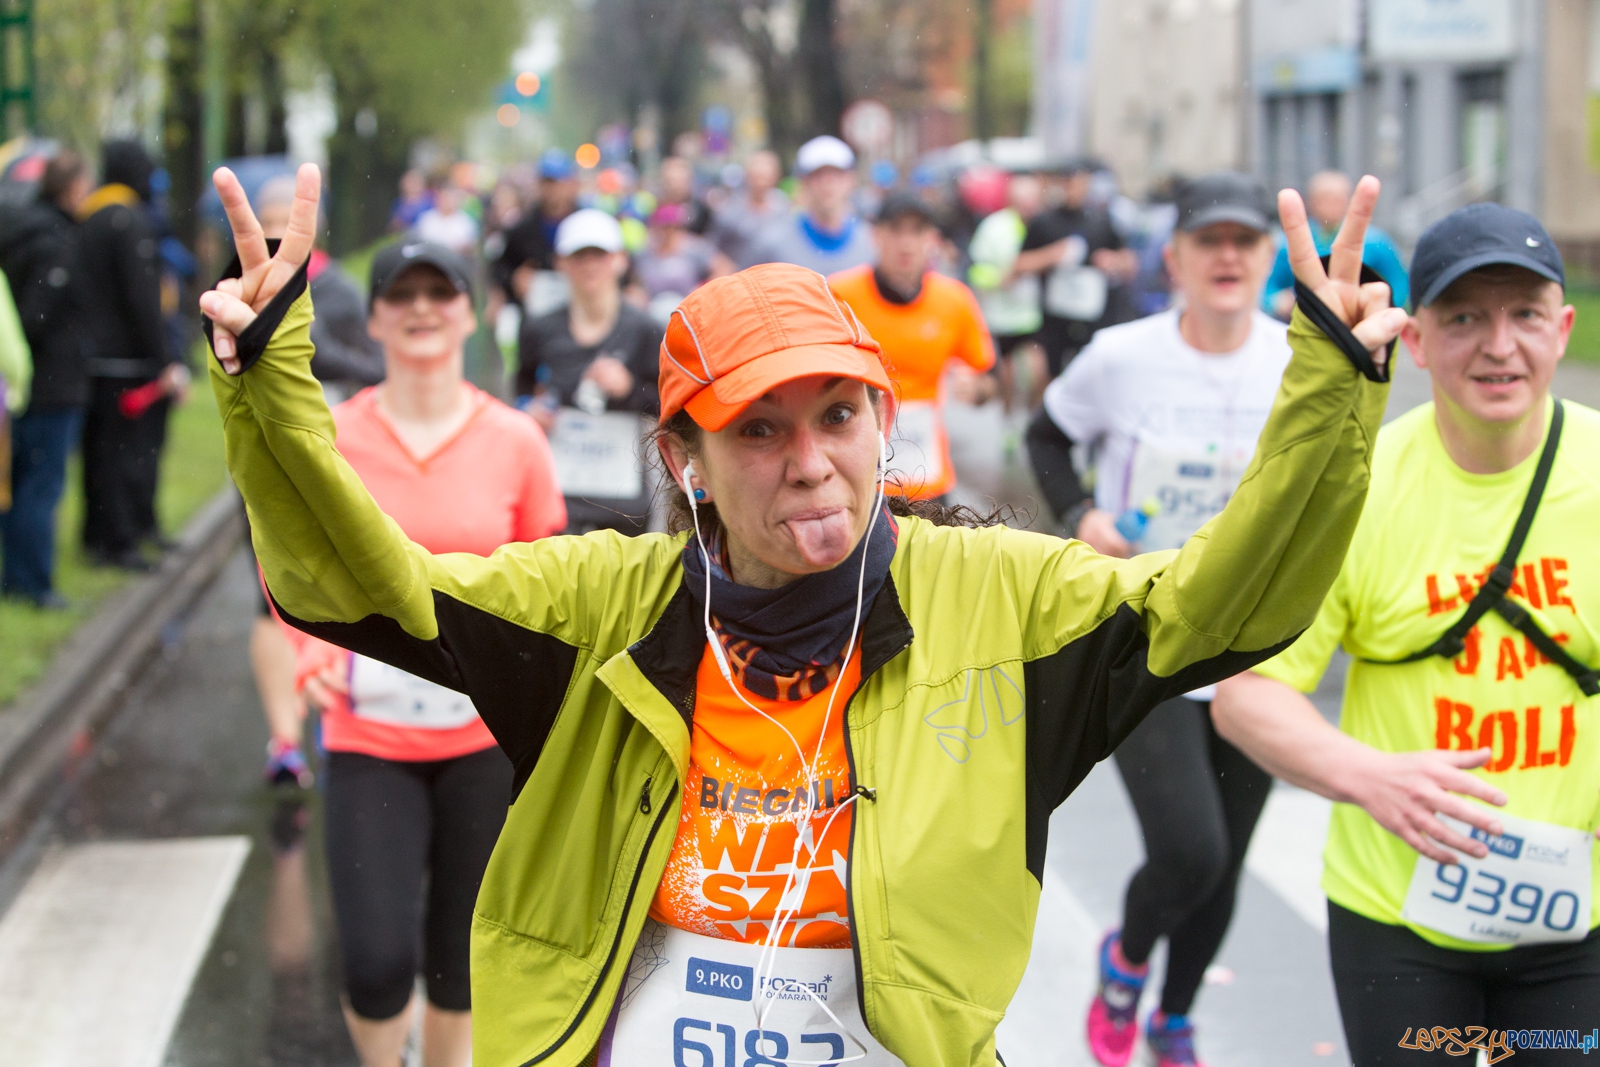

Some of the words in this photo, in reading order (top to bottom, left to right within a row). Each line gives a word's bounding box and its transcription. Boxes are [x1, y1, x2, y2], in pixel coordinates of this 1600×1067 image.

[1434, 696, 1577, 773] BOLI
[1430, 861, 1580, 932] 9390
[760, 990, 828, 1002] ÓMARATN
